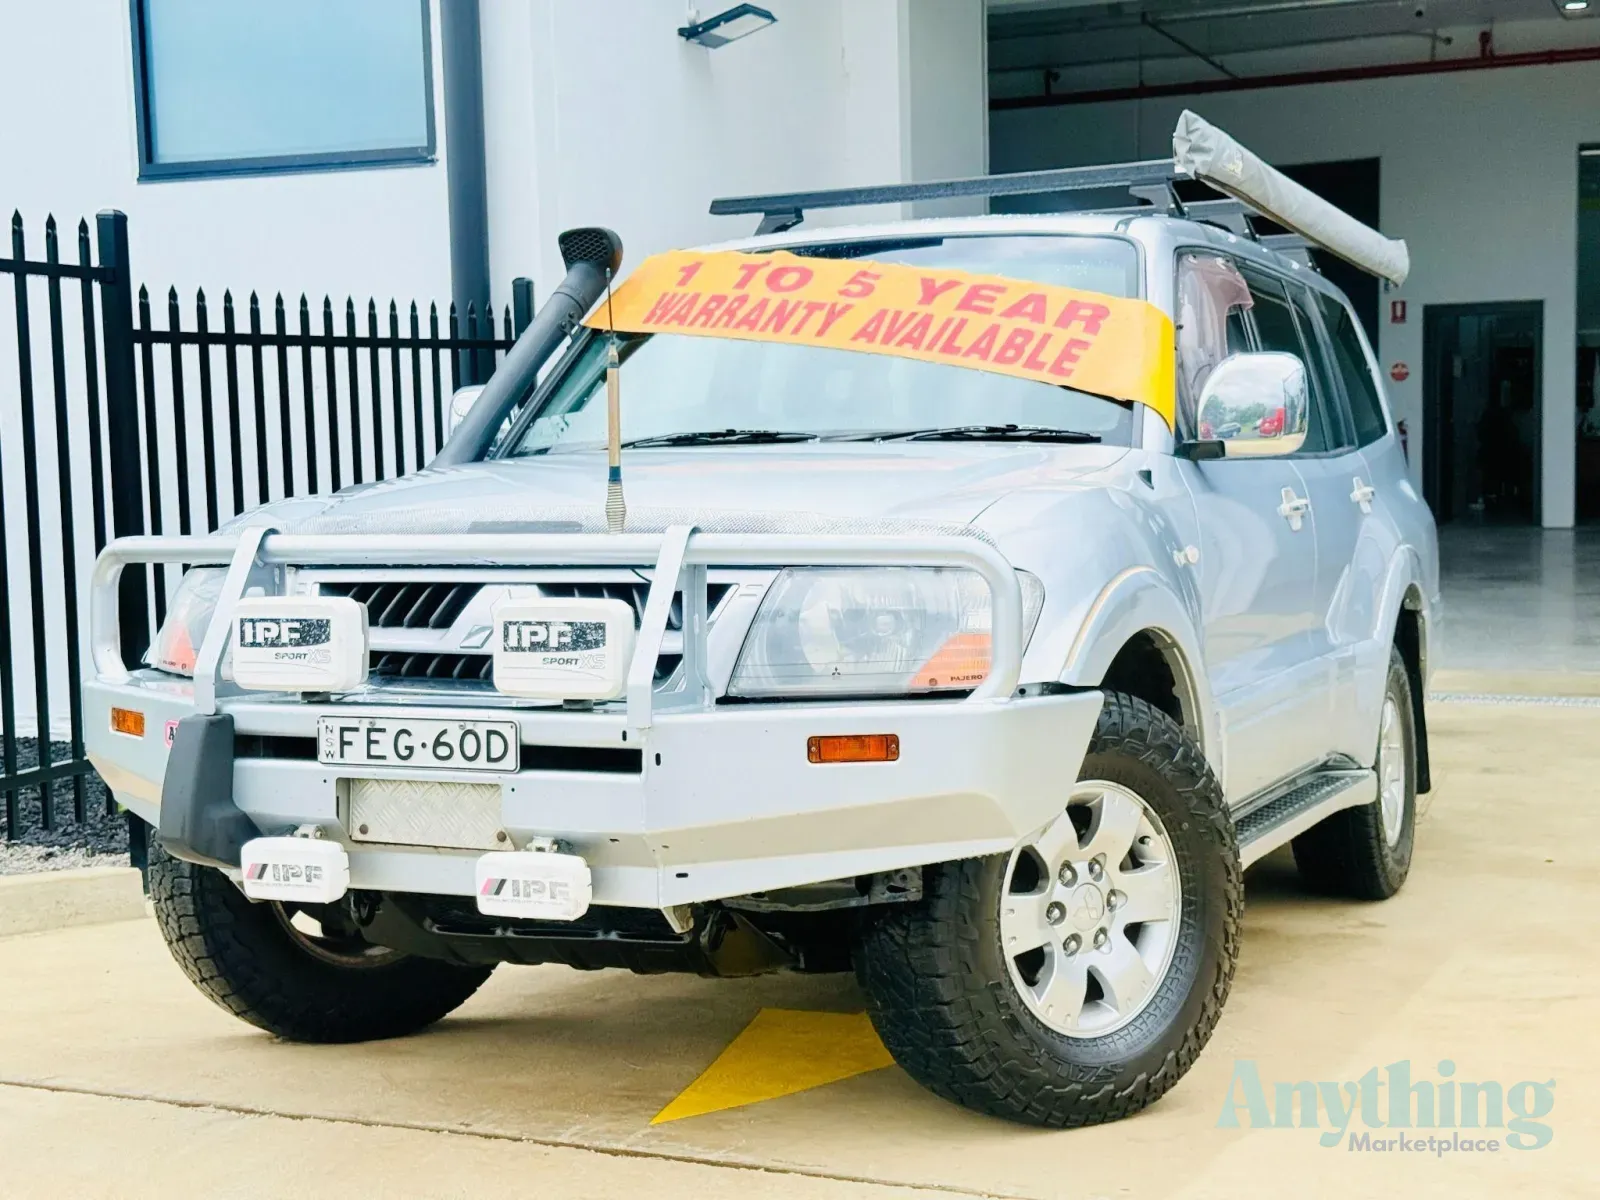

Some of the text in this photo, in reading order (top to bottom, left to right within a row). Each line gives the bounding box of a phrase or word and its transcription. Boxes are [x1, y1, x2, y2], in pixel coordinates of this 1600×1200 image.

[676, 260, 1111, 337] 1 TO 5 YEAR
[642, 292, 1093, 378] WARRANTY AVAILABLE
[244, 621, 301, 644] IPF
[507, 624, 572, 648] IPF
[274, 652, 309, 660] SPORT
[542, 656, 580, 666] SPORT
[950, 673, 984, 682] PAJERO
[272, 863, 323, 883] IPF
[511, 879, 570, 900] IPF
